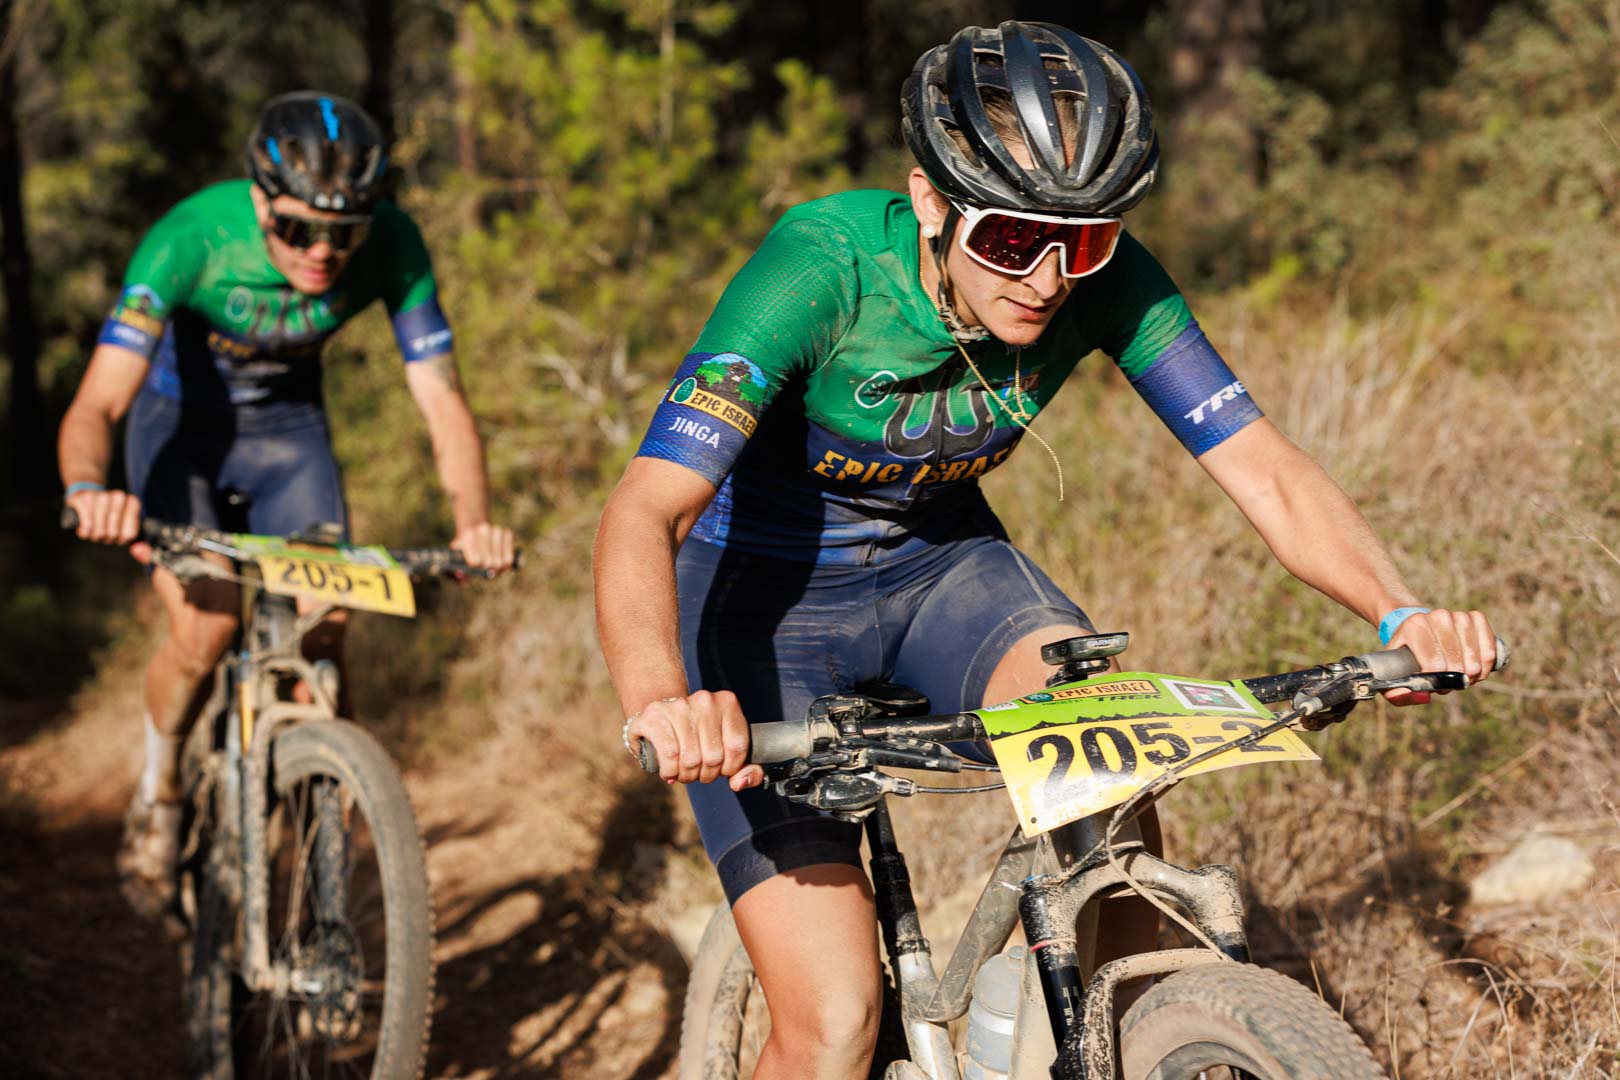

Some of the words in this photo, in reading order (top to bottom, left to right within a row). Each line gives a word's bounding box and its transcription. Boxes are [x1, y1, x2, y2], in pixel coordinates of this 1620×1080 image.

[691, 392, 720, 411] EPIC
[1183, 380, 1247, 424] TRE
[668, 416, 720, 448] JINGA
[813, 449, 904, 483] EPIC
[276, 560, 391, 601] 205-1
[1056, 688, 1092, 698] EPIC
[1095, 682, 1151, 693] ISRAEL
[1027, 720, 1286, 808] 205-2
